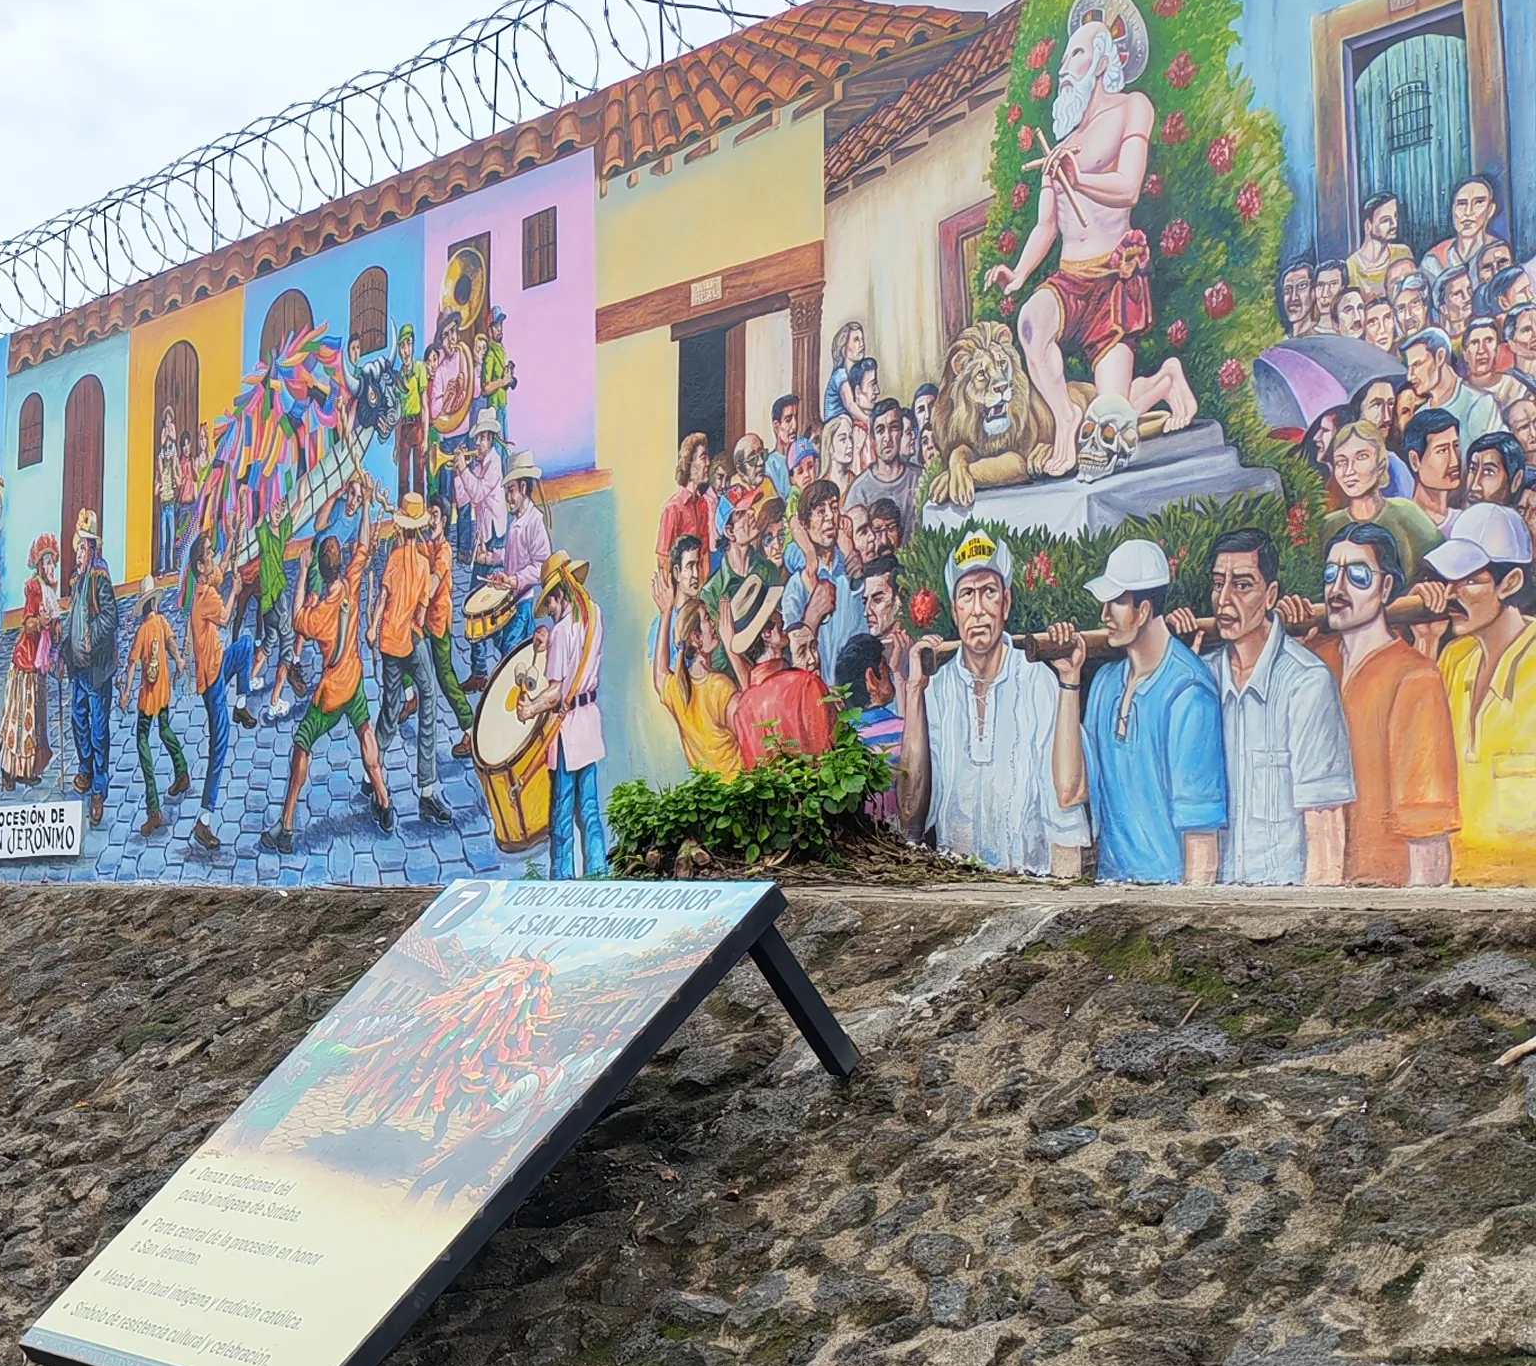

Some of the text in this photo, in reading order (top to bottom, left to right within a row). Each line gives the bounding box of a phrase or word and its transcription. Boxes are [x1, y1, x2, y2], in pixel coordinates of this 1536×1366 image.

[51, 808, 65, 824] DE
[7, 823, 75, 855] JERÓNIMO
[432, 891, 481, 930] 7
[504, 885, 722, 911] TORO HUACO EN HONOR
[500, 911, 658, 940] A SAN JERÓNIMO
[196, 1166, 298, 1197] Danza tradicional del
[174, 1187, 213, 1205] pueblo
[207, 1191, 252, 1212] indígena
[247, 1198, 266, 1216] de
[137, 1238, 159, 1255] San
[148, 1217, 177, 1236] Parte
[173, 1226, 213, 1243] central
[205, 1228, 223, 1245] de
[224, 1237, 279, 1258] procesión
[275, 1246, 293, 1260] en
[288, 1245, 325, 1267] honor
[99, 1268, 136, 1290] Mezcla
[131, 1275, 148, 1292] de
[143, 1279, 177, 1299] ritual
[166, 1283, 213, 1308] indígena
[215, 1297, 263, 1321] tradición
[69, 1301, 110, 1324] Símbolo
[104, 1309, 122, 1327] de
[115, 1316, 171, 1341] resistencia
[165, 1327, 211, 1350] cultural
